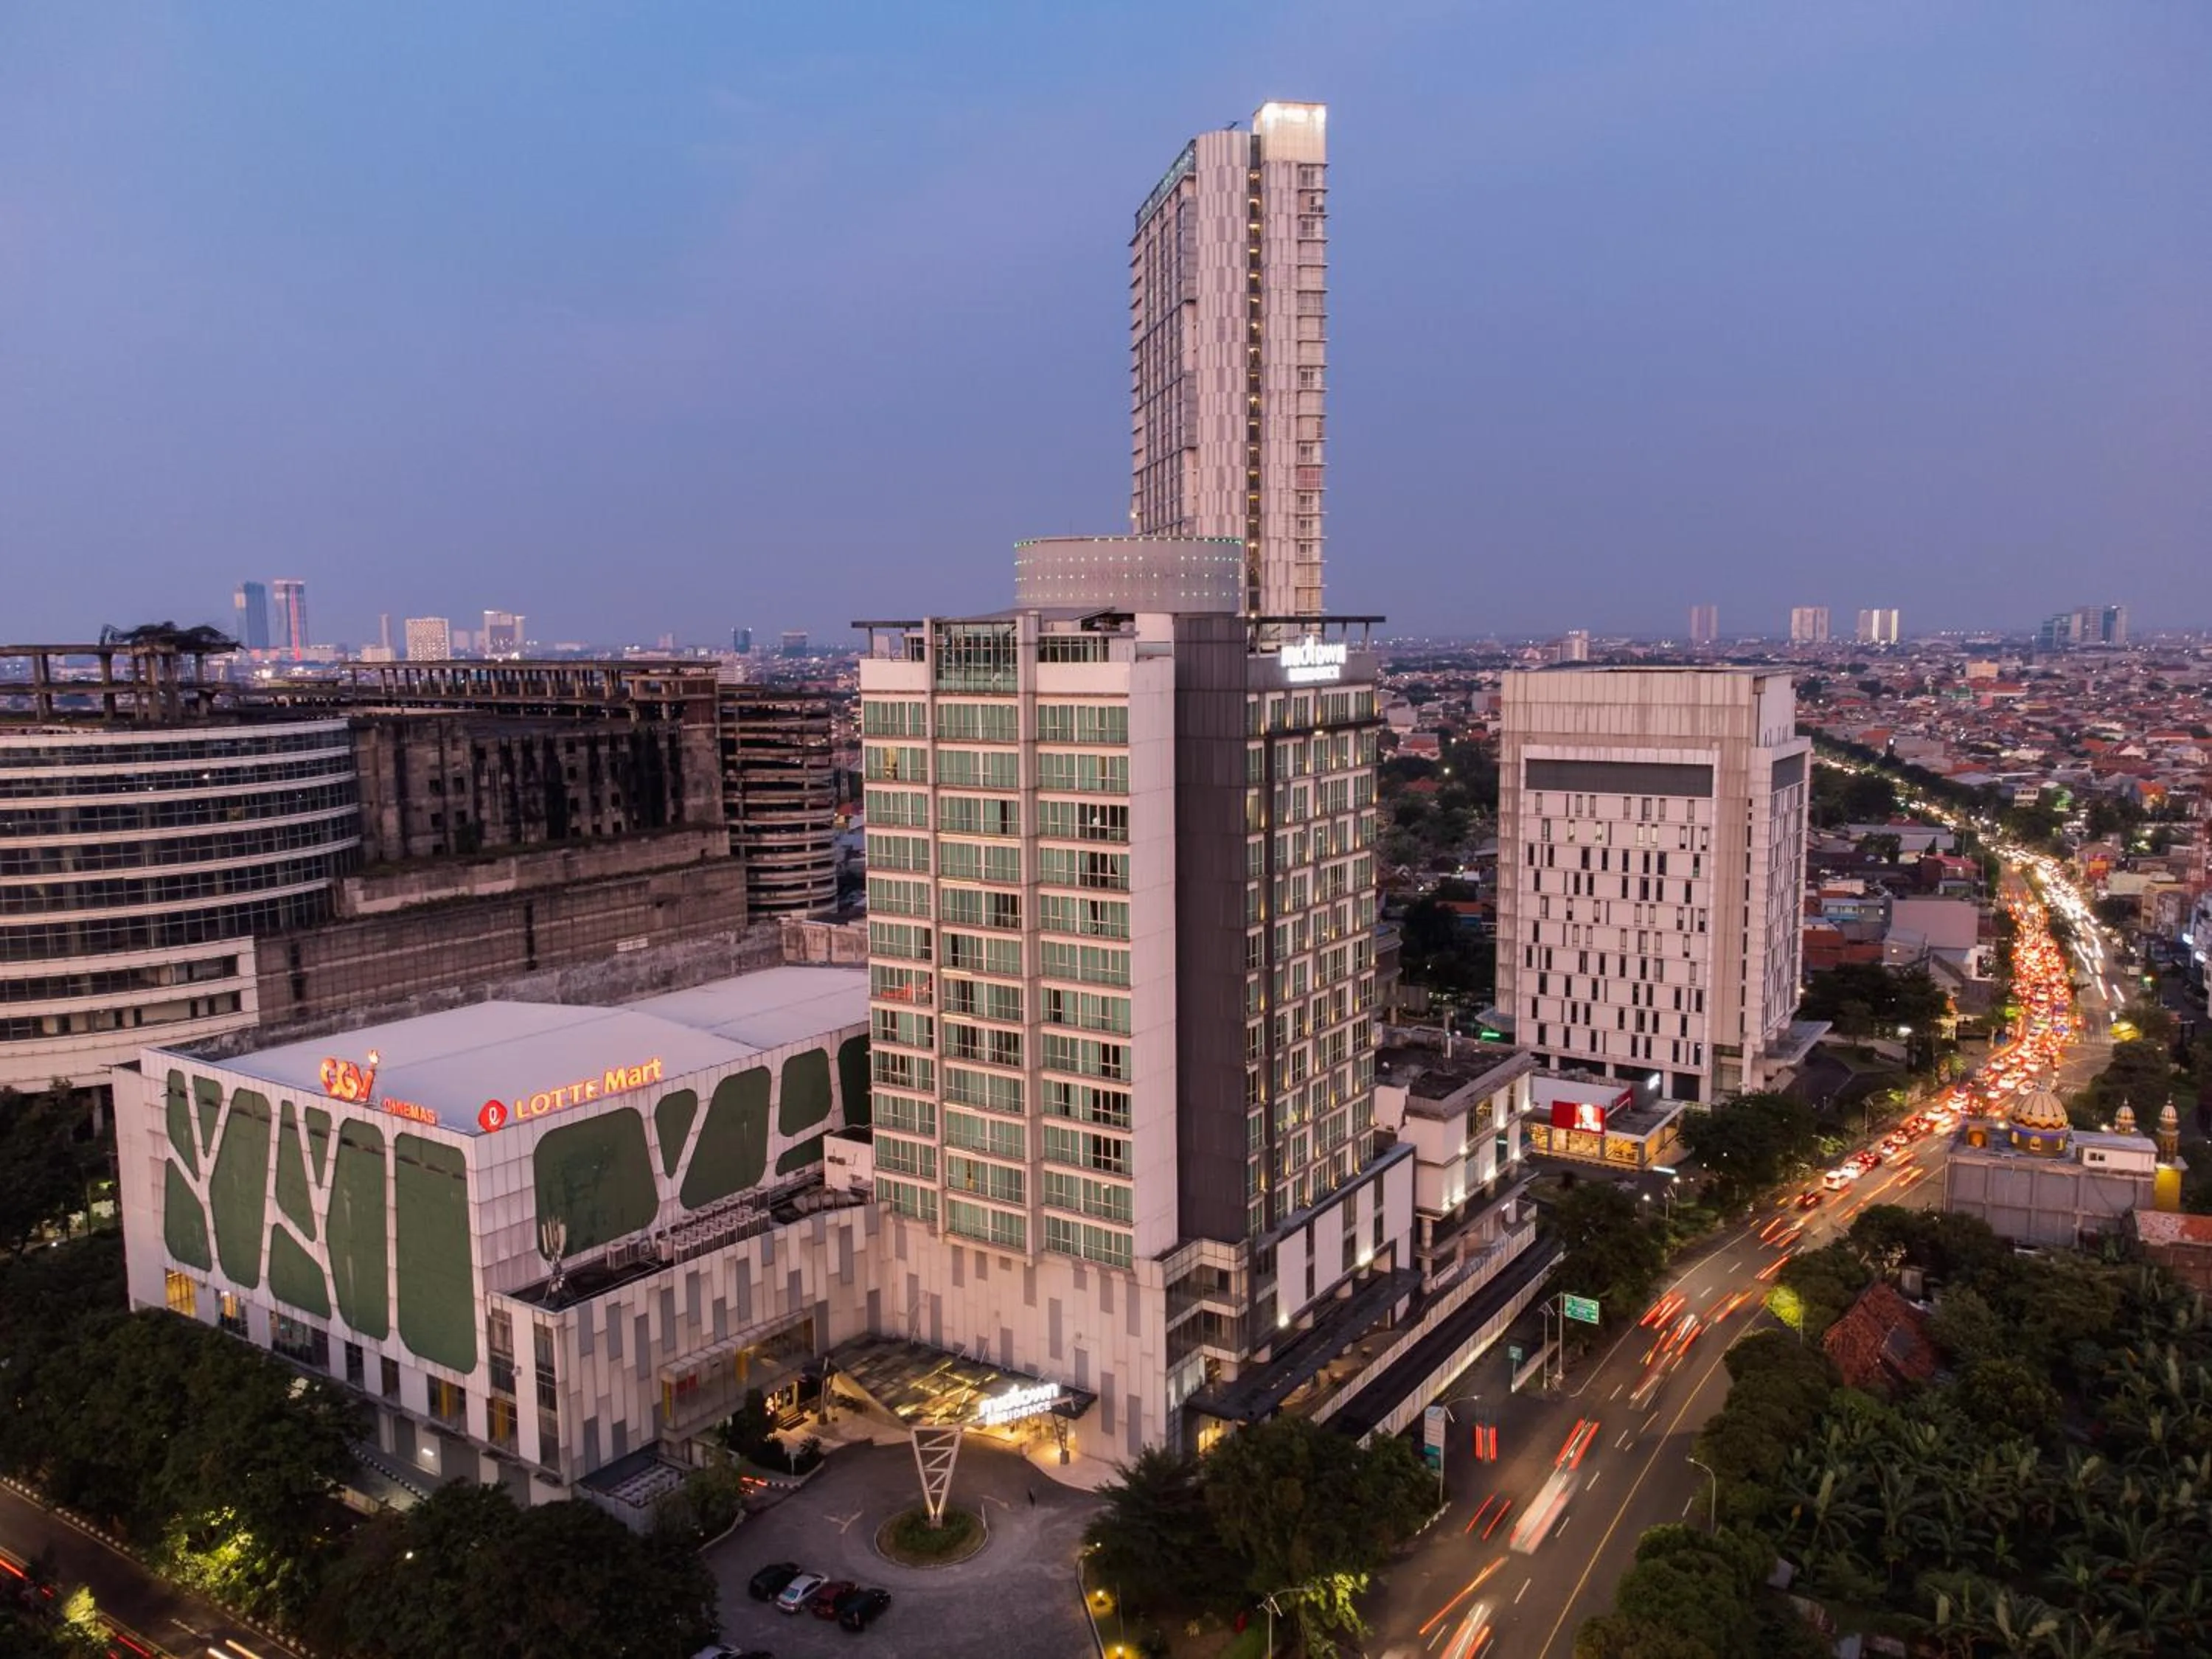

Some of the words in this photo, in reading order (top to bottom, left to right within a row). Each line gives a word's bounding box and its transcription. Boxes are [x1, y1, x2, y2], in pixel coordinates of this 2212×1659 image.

[320, 1057, 375, 1102] CGV
[515, 1079, 600, 1119] LOTTE
[604, 1057, 661, 1093] Mart
